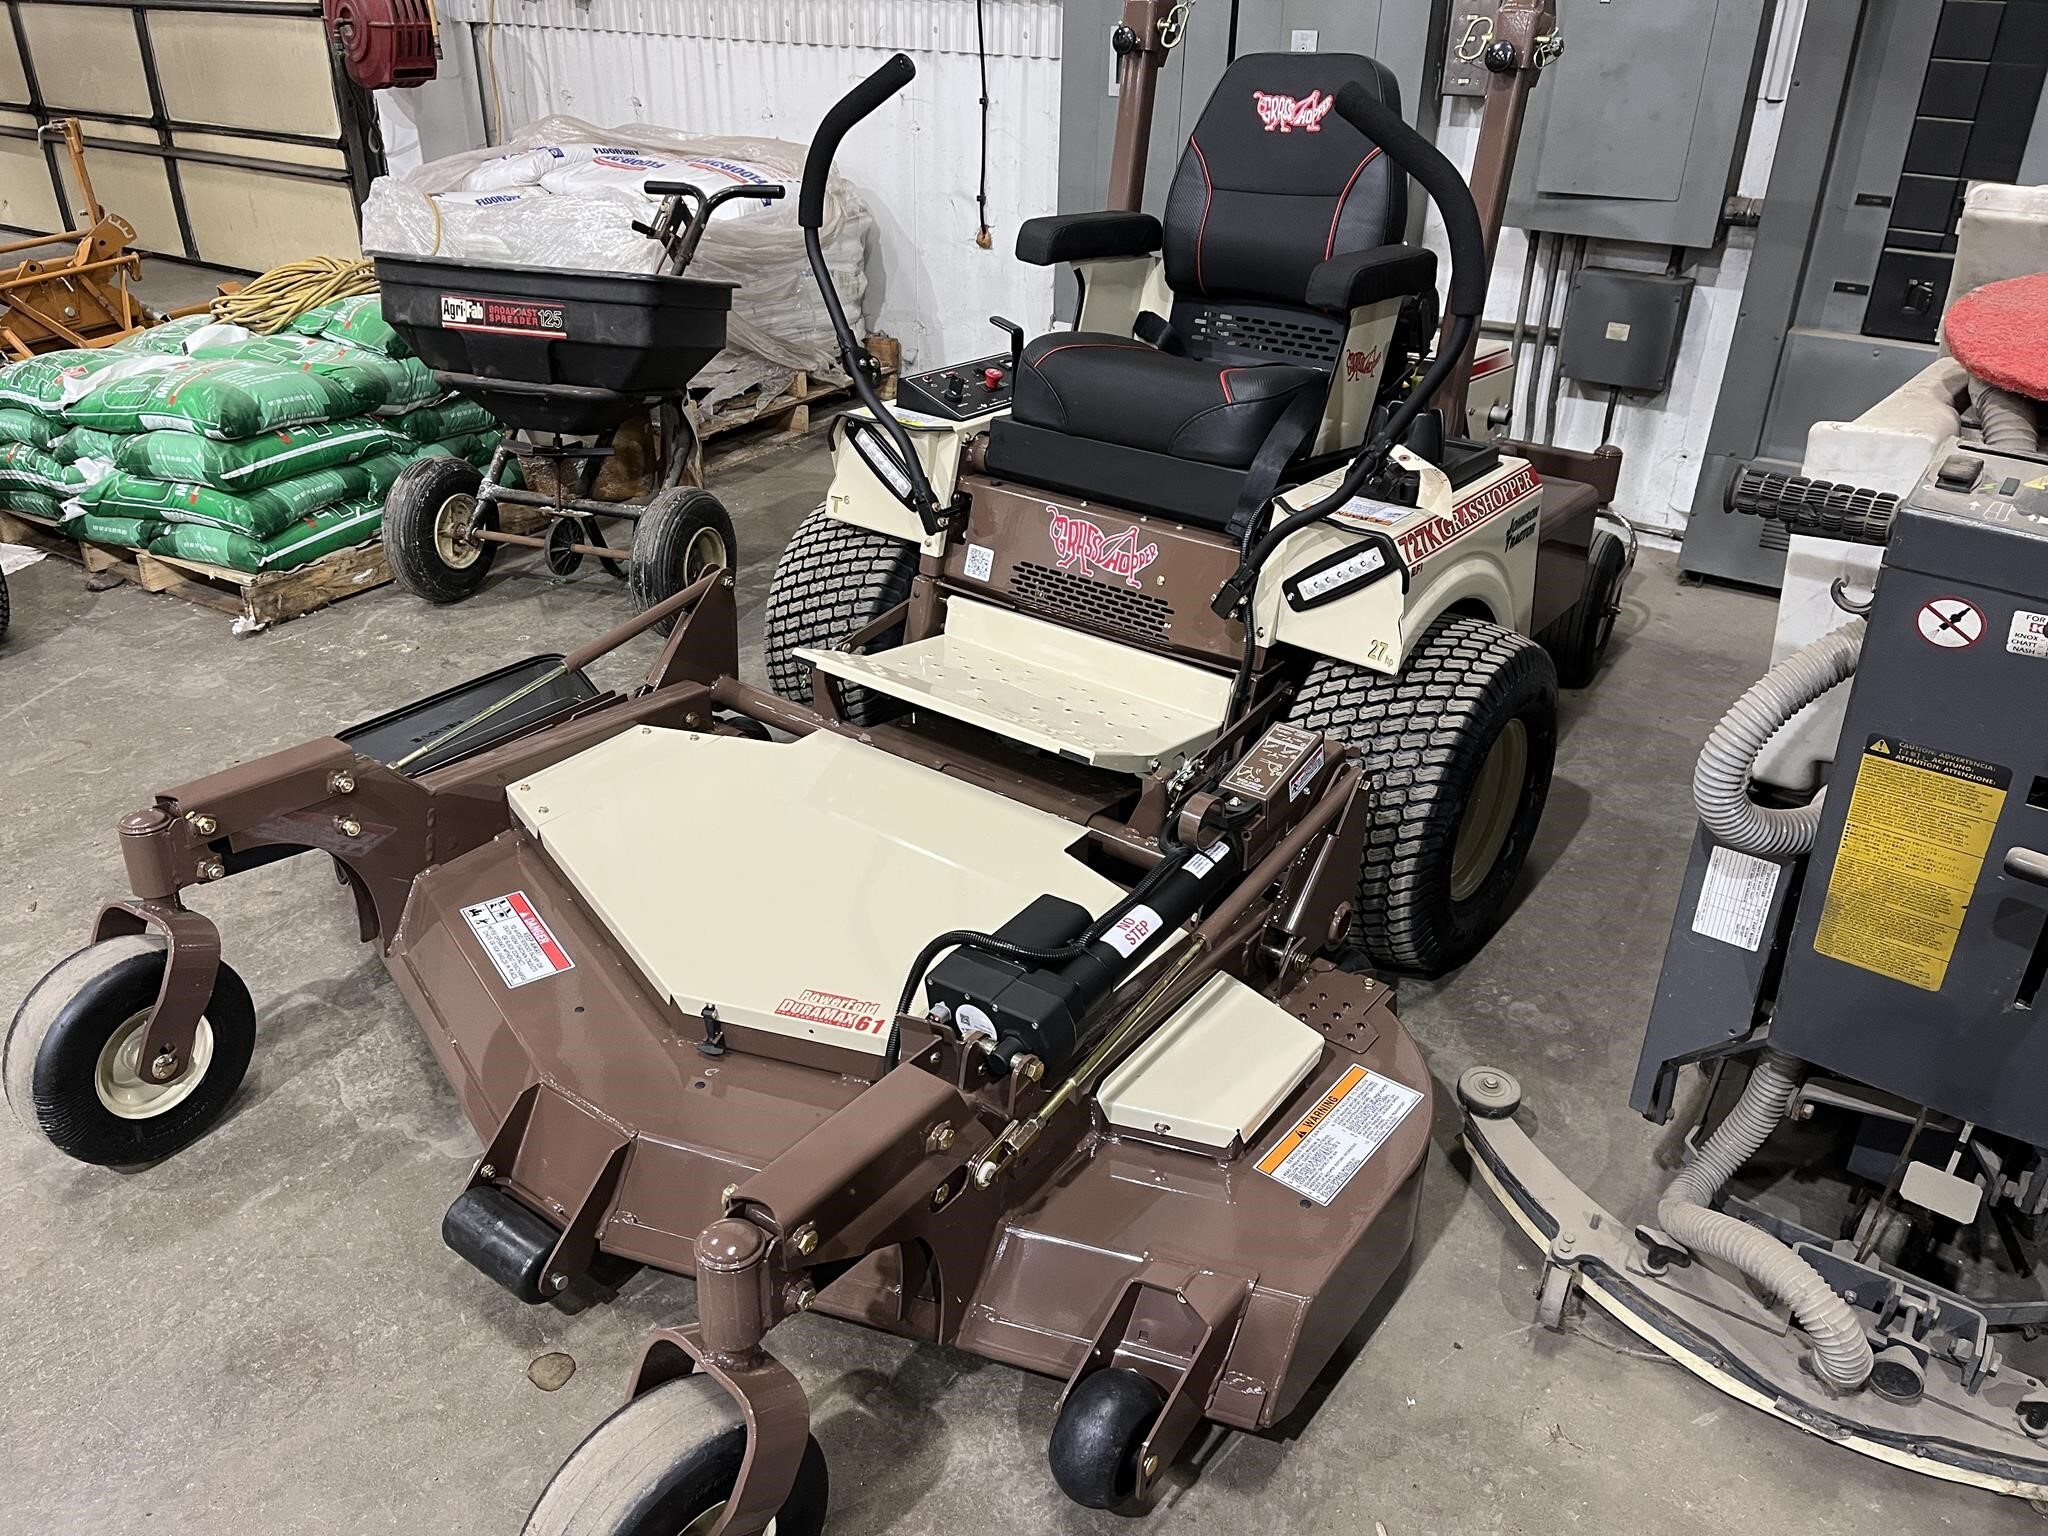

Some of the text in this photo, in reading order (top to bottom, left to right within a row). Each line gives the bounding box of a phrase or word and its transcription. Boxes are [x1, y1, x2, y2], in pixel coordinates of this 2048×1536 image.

[489, 305, 538, 317] BROADCAST
[489, 314, 538, 326] SPREADER
[538, 309, 563, 328] 125
[1398, 521, 1442, 563] 727K
[1441, 470, 1534, 537] GRASSHOPPER
[1411, 563, 1423, 577] EFI
[2026, 615, 2046, 623] FOR
[2011, 639, 2037, 648] CHATT
[2015, 633, 2038, 641] KNOX
[2012, 646, 2036, 655] NASH
[1117, 918, 1135, 931] NO
[1125, 920, 1149, 946] STEP
[855, 1016, 885, 1034] 61
[1302, 1095, 1338, 1128] WARNING
